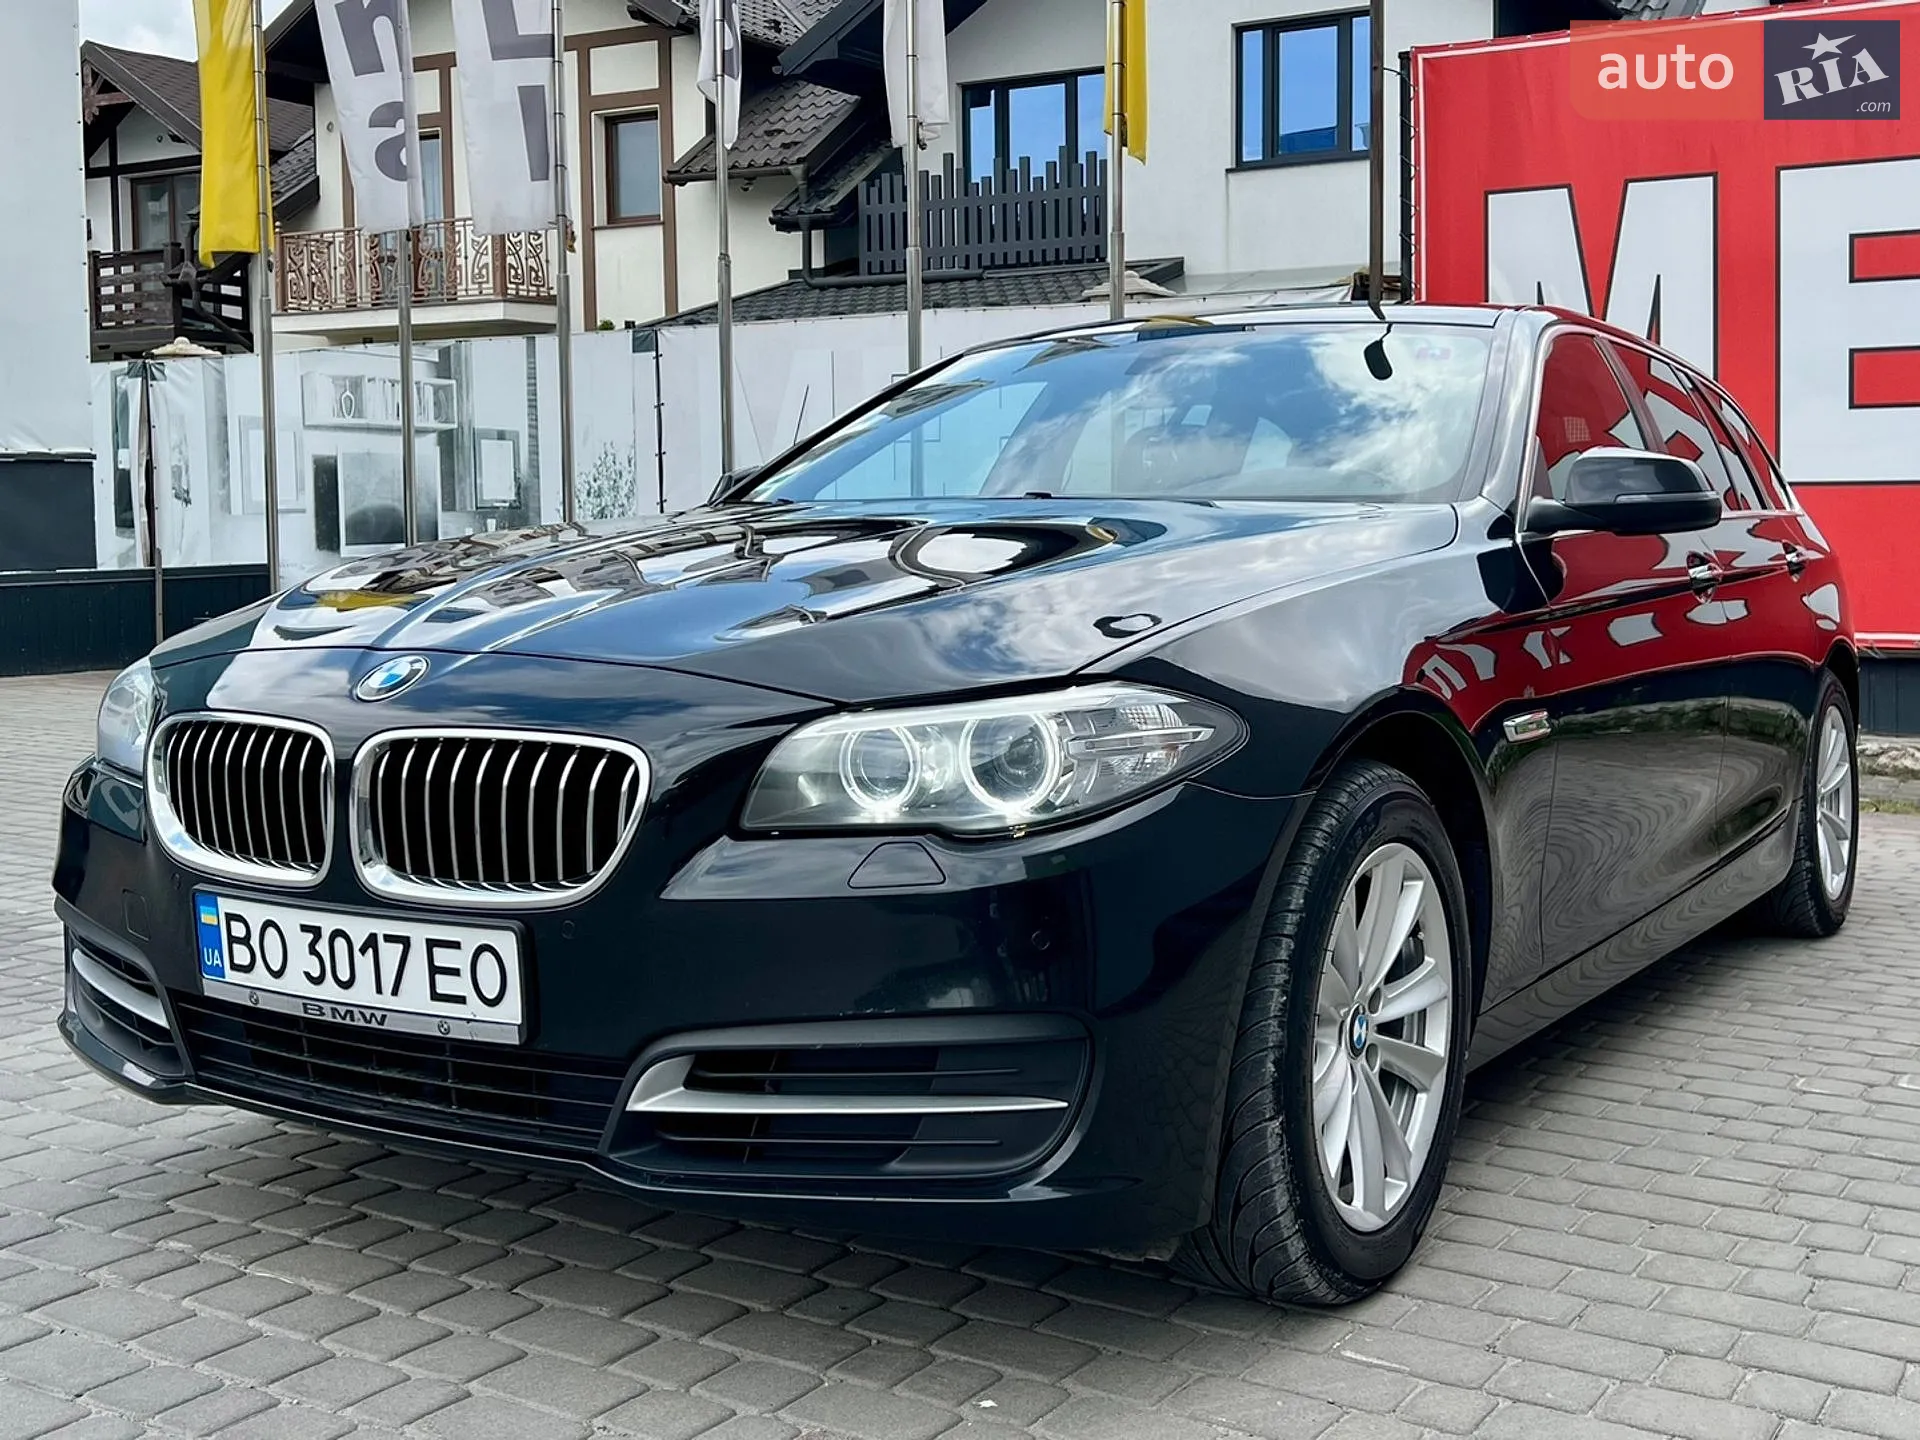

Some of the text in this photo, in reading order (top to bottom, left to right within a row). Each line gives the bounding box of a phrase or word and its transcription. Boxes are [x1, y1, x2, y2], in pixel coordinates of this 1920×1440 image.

[203, 947, 223, 968] UA
[224, 911, 508, 1008] BO 3017 EO
[302, 1002, 388, 1027] BMW
